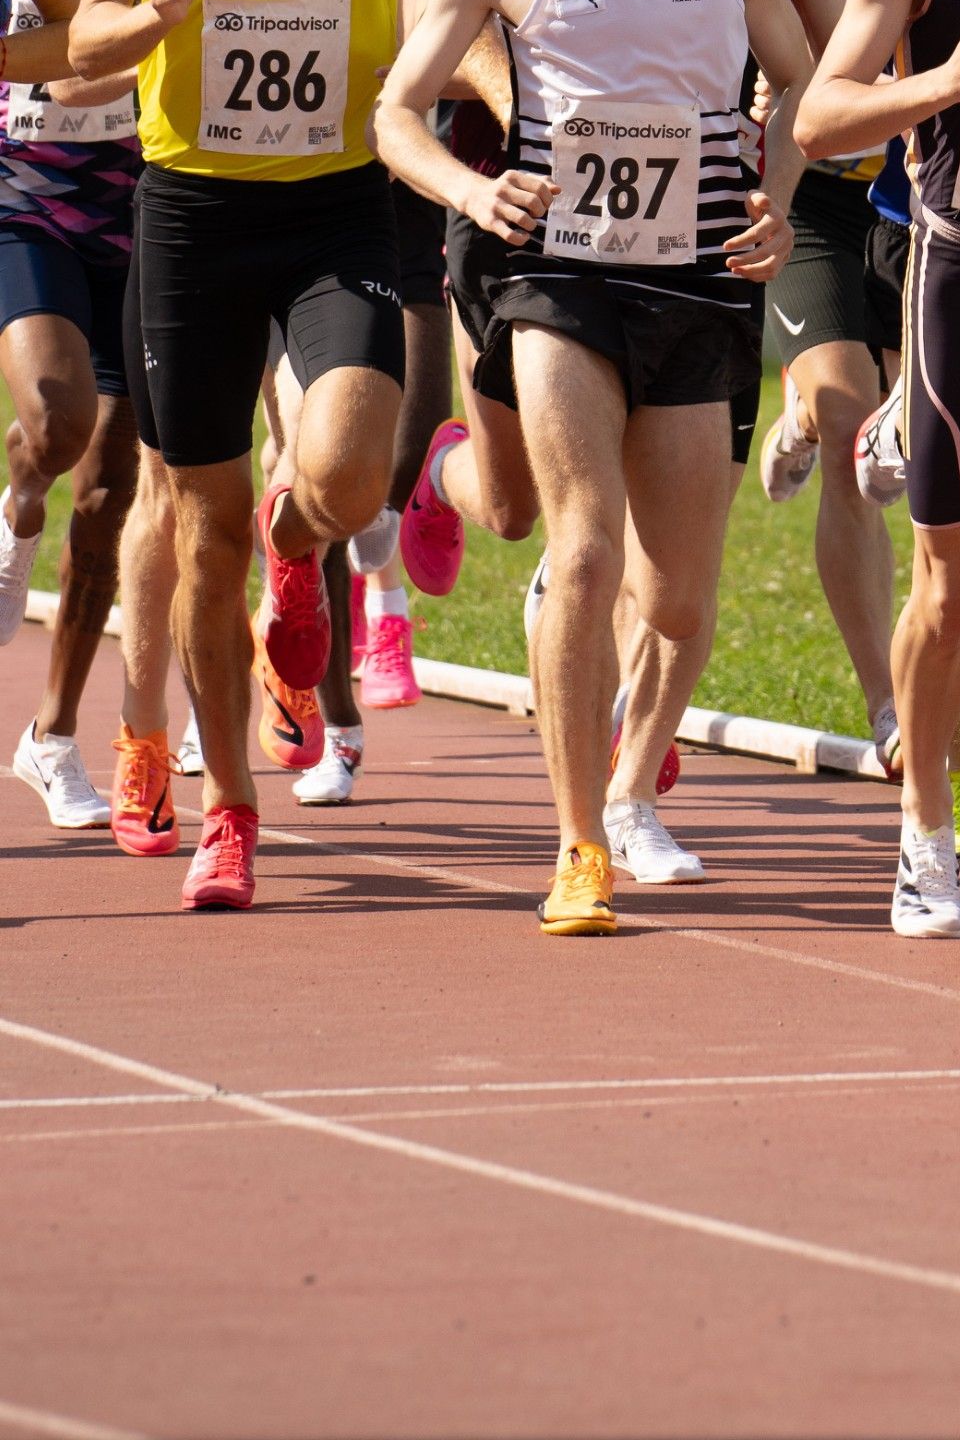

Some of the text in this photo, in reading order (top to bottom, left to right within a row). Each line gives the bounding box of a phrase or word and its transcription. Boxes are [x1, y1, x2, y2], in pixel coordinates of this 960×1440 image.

[246, 15, 340, 33] Tripadvisor
[223, 48, 327, 112] 286
[15, 115, 46, 130] IMC
[597, 121, 692, 140] Tripadvisor
[206, 123, 243, 141] IMC
[572, 152, 680, 220] 287
[554, 229, 592, 247] IMC
[361, 280, 402, 308] RUN
